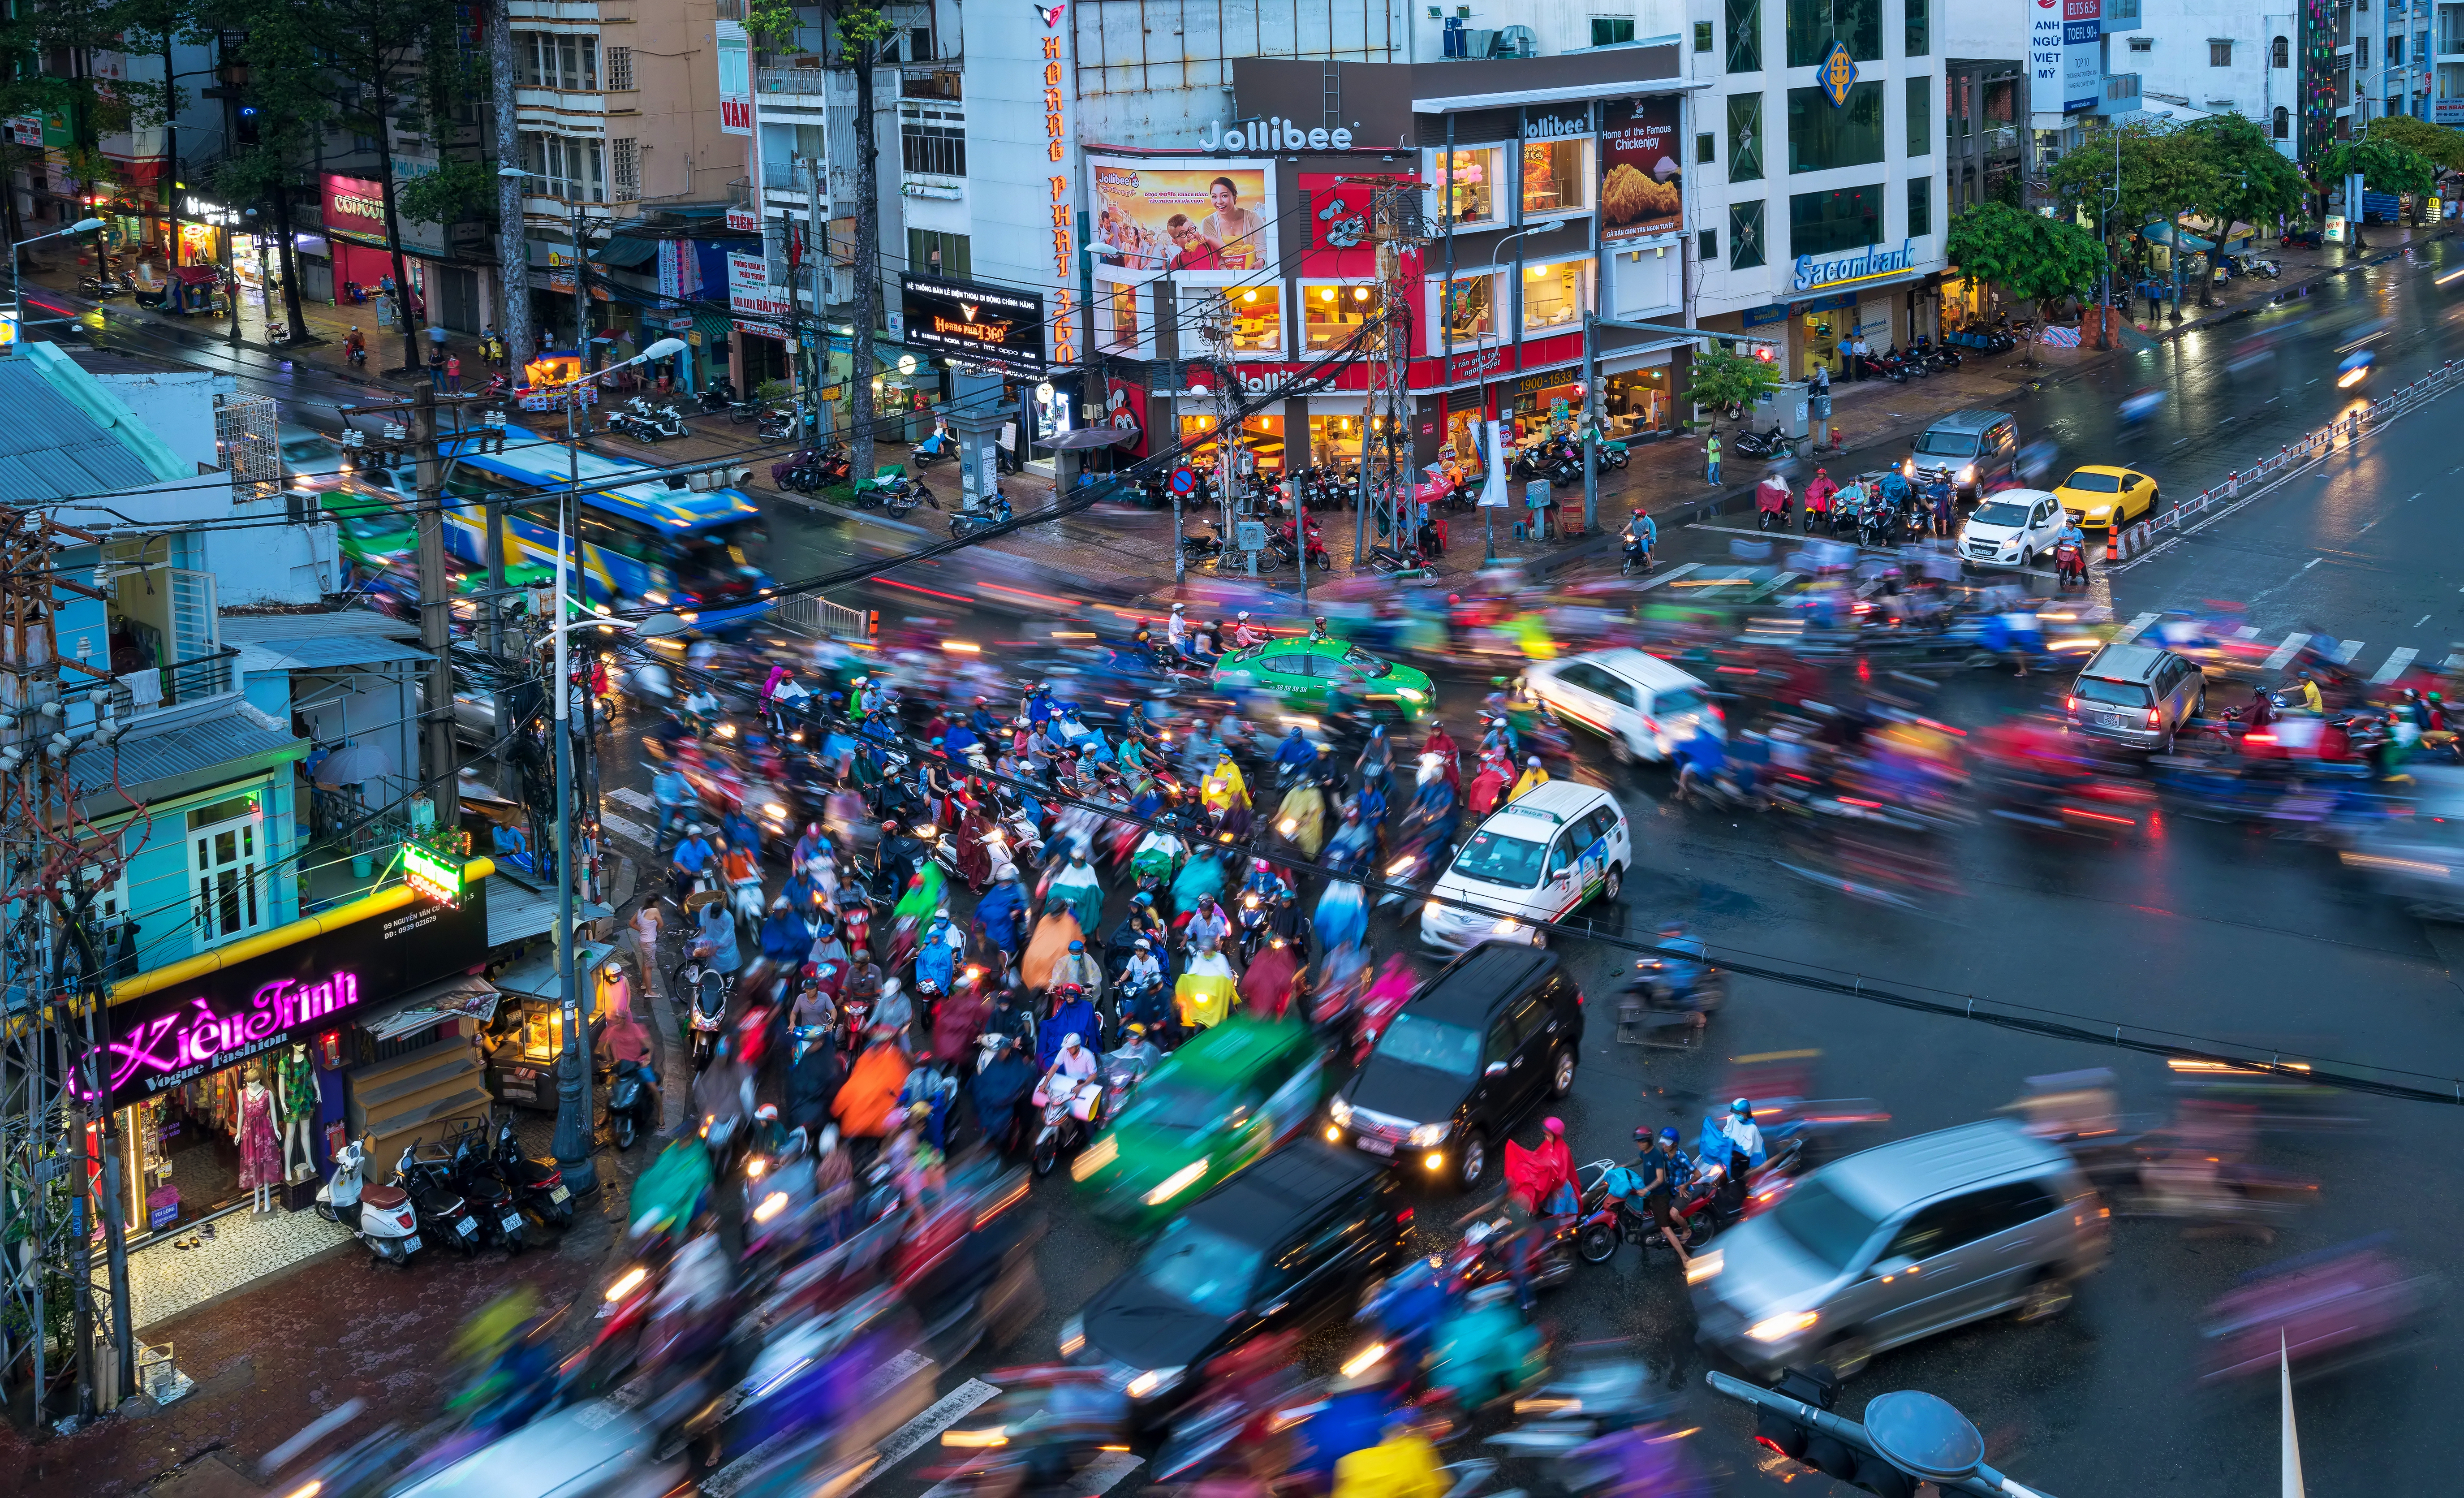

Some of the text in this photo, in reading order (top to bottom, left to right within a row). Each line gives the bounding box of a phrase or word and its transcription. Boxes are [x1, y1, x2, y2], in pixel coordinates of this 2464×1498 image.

[2068, 1, 2097, 15] IELTS 6.5+
[2035, 22, 2059, 30] ANH
[2067, 26, 2097, 40] TOEFL 90+
[2033, 35, 2061, 46] NGỮ
[2033, 52, 2061, 64] VIỆT
[2075, 57, 2089, 68] TOP 10
[2038, 68, 2055, 78] MỸ
[722, 98, 750, 128] VÂN
[1198, 117, 1353, 151] Jollibee
[1602, 124, 1671, 139] Home of the Famous
[1615, 137, 1659, 151] Chickenjoy
[398, 159, 414, 177] HÒA
[1099, 173, 1130, 185] Jollibee
[1110, 186, 1120, 195] Giòn
[728, 214, 753, 230] TIÊN
[1606, 230, 1614, 238] GÀ
[1614, 228, 1624, 237] RÁN
[1660, 221, 1674, 232] TUYỆT
[734, 260, 761, 270] PHÒNG KHÁM
[1794, 238, 1916, 290] Sacombank
[751, 273, 765, 282] THUẬT
[915, 283, 932, 293] THỐNG
[933, 285, 943, 294] BÁN
[944, 287, 950, 296] LẺ
[952, 290, 963, 299] ĐIỆN
[964, 292, 978, 301] THOẠI
[986, 295, 1001, 304] ĐỘNG
[1002, 297, 1018, 307] CHÍNH
[1020, 299, 1034, 310] HÃNG
[734, 296, 772, 313] NHA KHOA HẢI
[743, 323, 766, 333] Hair
[922, 332, 941, 342] SAMSUNG
[944, 337, 960, 345] NOKIA
[1458, 358, 1469, 367] rán
[1519, 371, 1572, 392] 1900-1533
[383, 903, 441, 931] 99 NGUYỄN VĂN CỪ
[384, 915, 437, 940] DĐ: 0939 021679
[68, 971, 358, 1100] Kiều Trinh
[145, 1031, 288, 1092] Vogue Fashion
[504, 1214, 518, 1226] 59-L2
[505, 1220, 522, 1232] 170.81
[406, 1243, 422, 1253] 760.84
